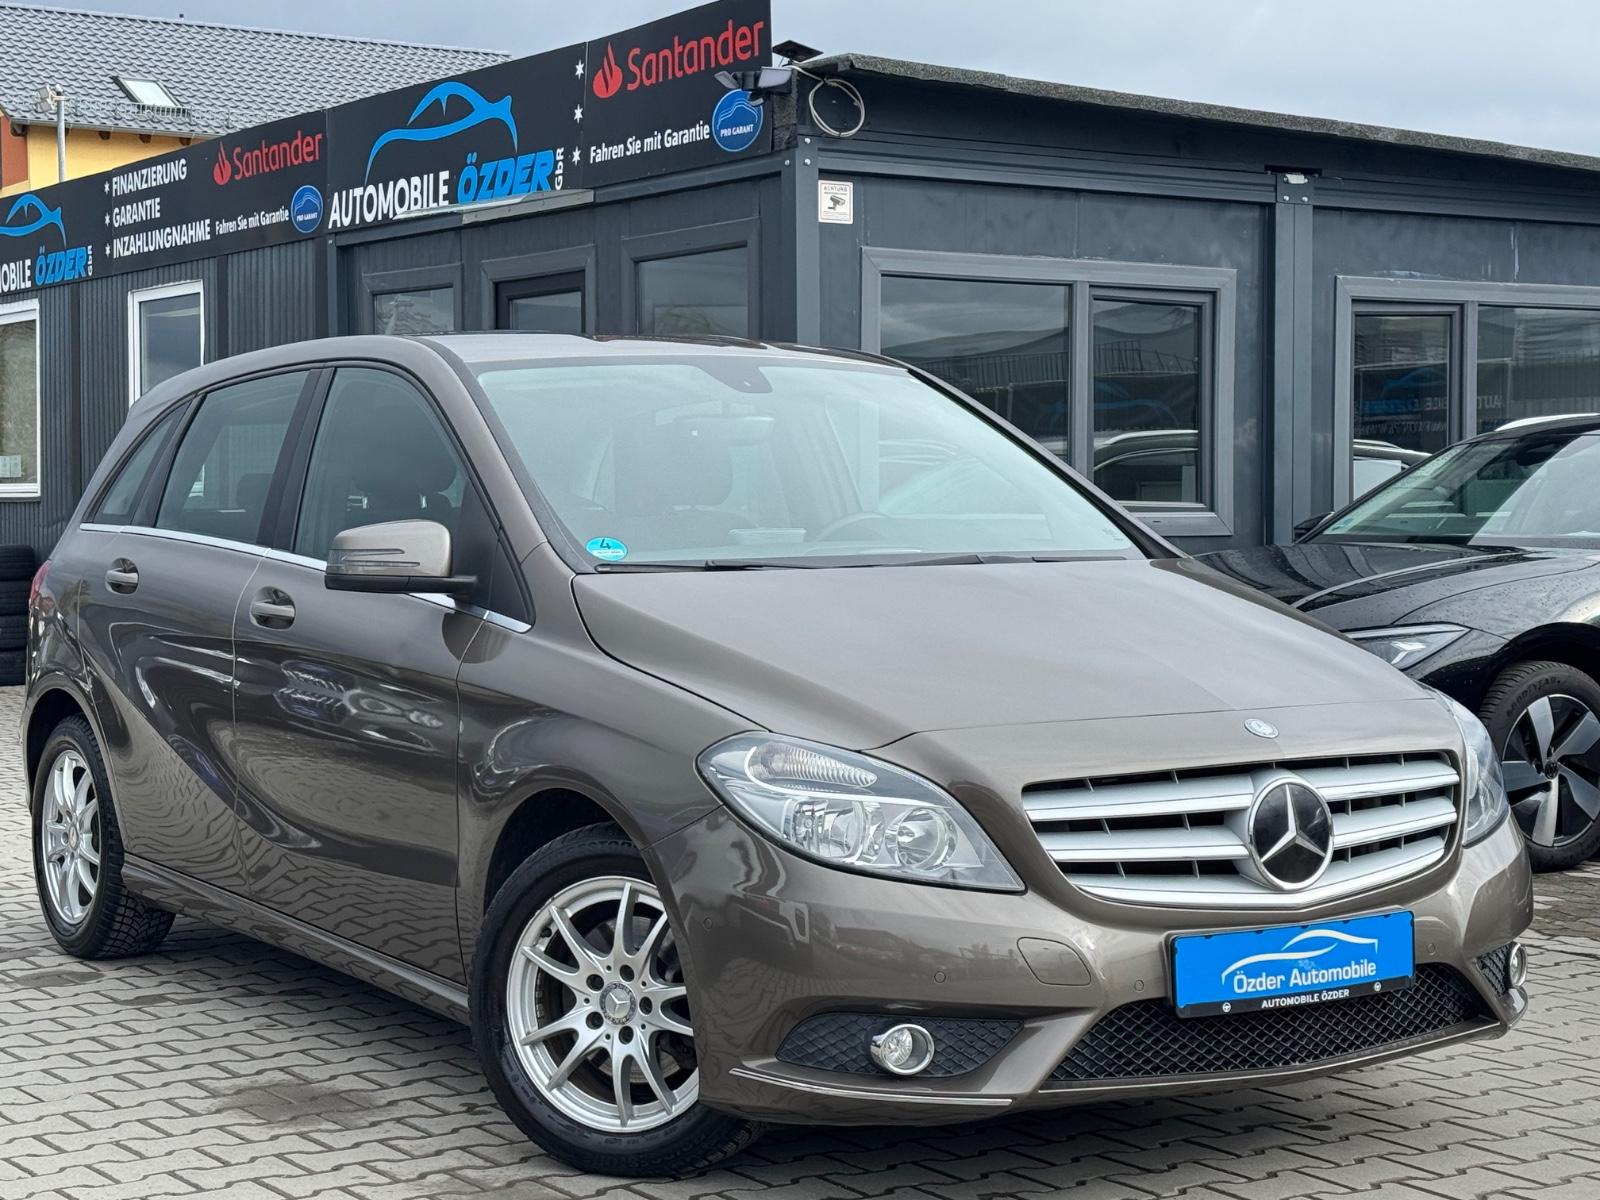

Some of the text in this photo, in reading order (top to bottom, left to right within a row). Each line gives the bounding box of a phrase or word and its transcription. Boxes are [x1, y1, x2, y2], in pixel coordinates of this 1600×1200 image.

[626, 19, 764, 91] Santander
[589, 120, 710, 164] Fahren Sie mit Garantie
[720, 124, 754, 138] PRO GARANT
[233, 130, 322, 180] Santander
[554, 147, 565, 191] GbR
[112, 158, 187, 197] FINANZIERUNG
[457, 149, 556, 205] ÖZDER
[112, 197, 161, 228] GARANTIE
[215, 205, 290, 235] Fahren Sie mit Garantie
[328, 170, 450, 230] AUTOMOBILE
[113, 218, 211, 259] INZAHLUNGNAHME
[0, 258, 32, 293] OBILE
[34, 245, 88, 286] ÖZDER
[600, 538, 611, 550] 4
[1233, 958, 1377, 994] Özder Automobile
[1261, 989, 1350, 1009] AUTOMOBILE ÖZDER
